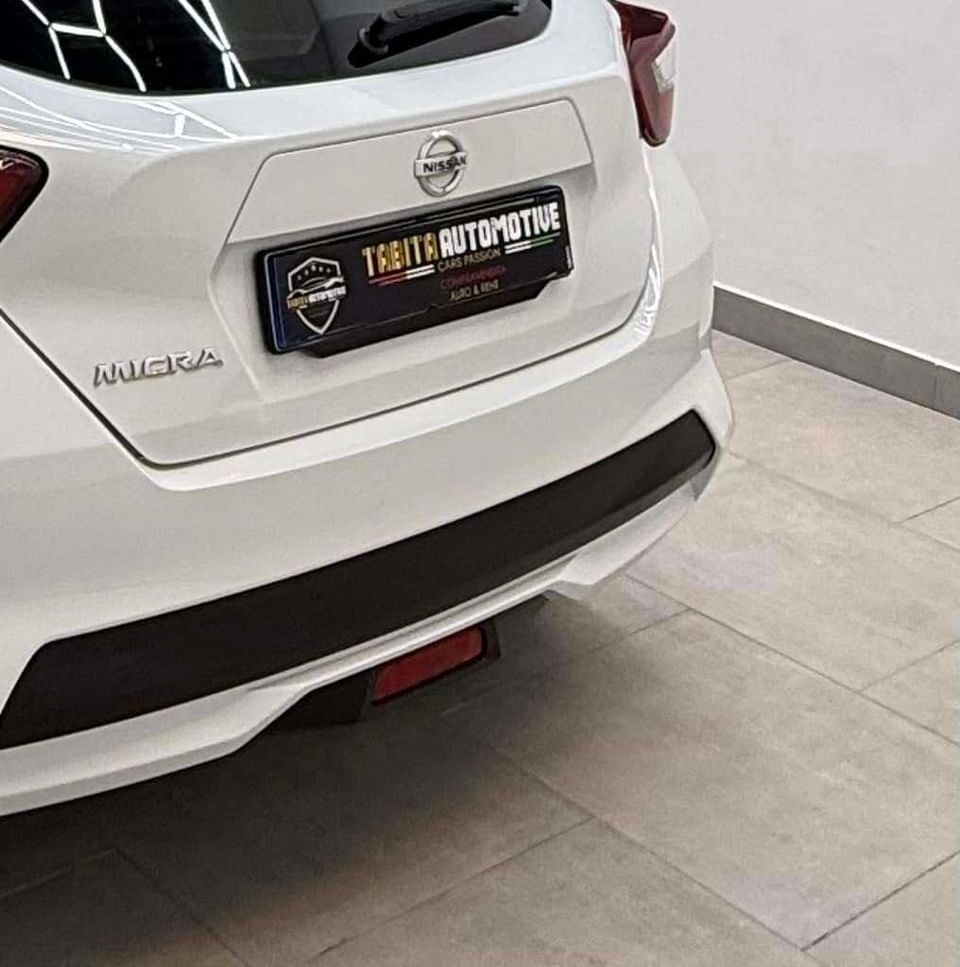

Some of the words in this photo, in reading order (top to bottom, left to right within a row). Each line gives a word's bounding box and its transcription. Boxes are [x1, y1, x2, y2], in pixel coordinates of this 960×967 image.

[423, 152, 467, 173] NISSAN
[362, 233, 438, 276] TABITA
[439, 201, 561, 258] AUTOMOTIVE
[93, 347, 224, 387] MICRA
